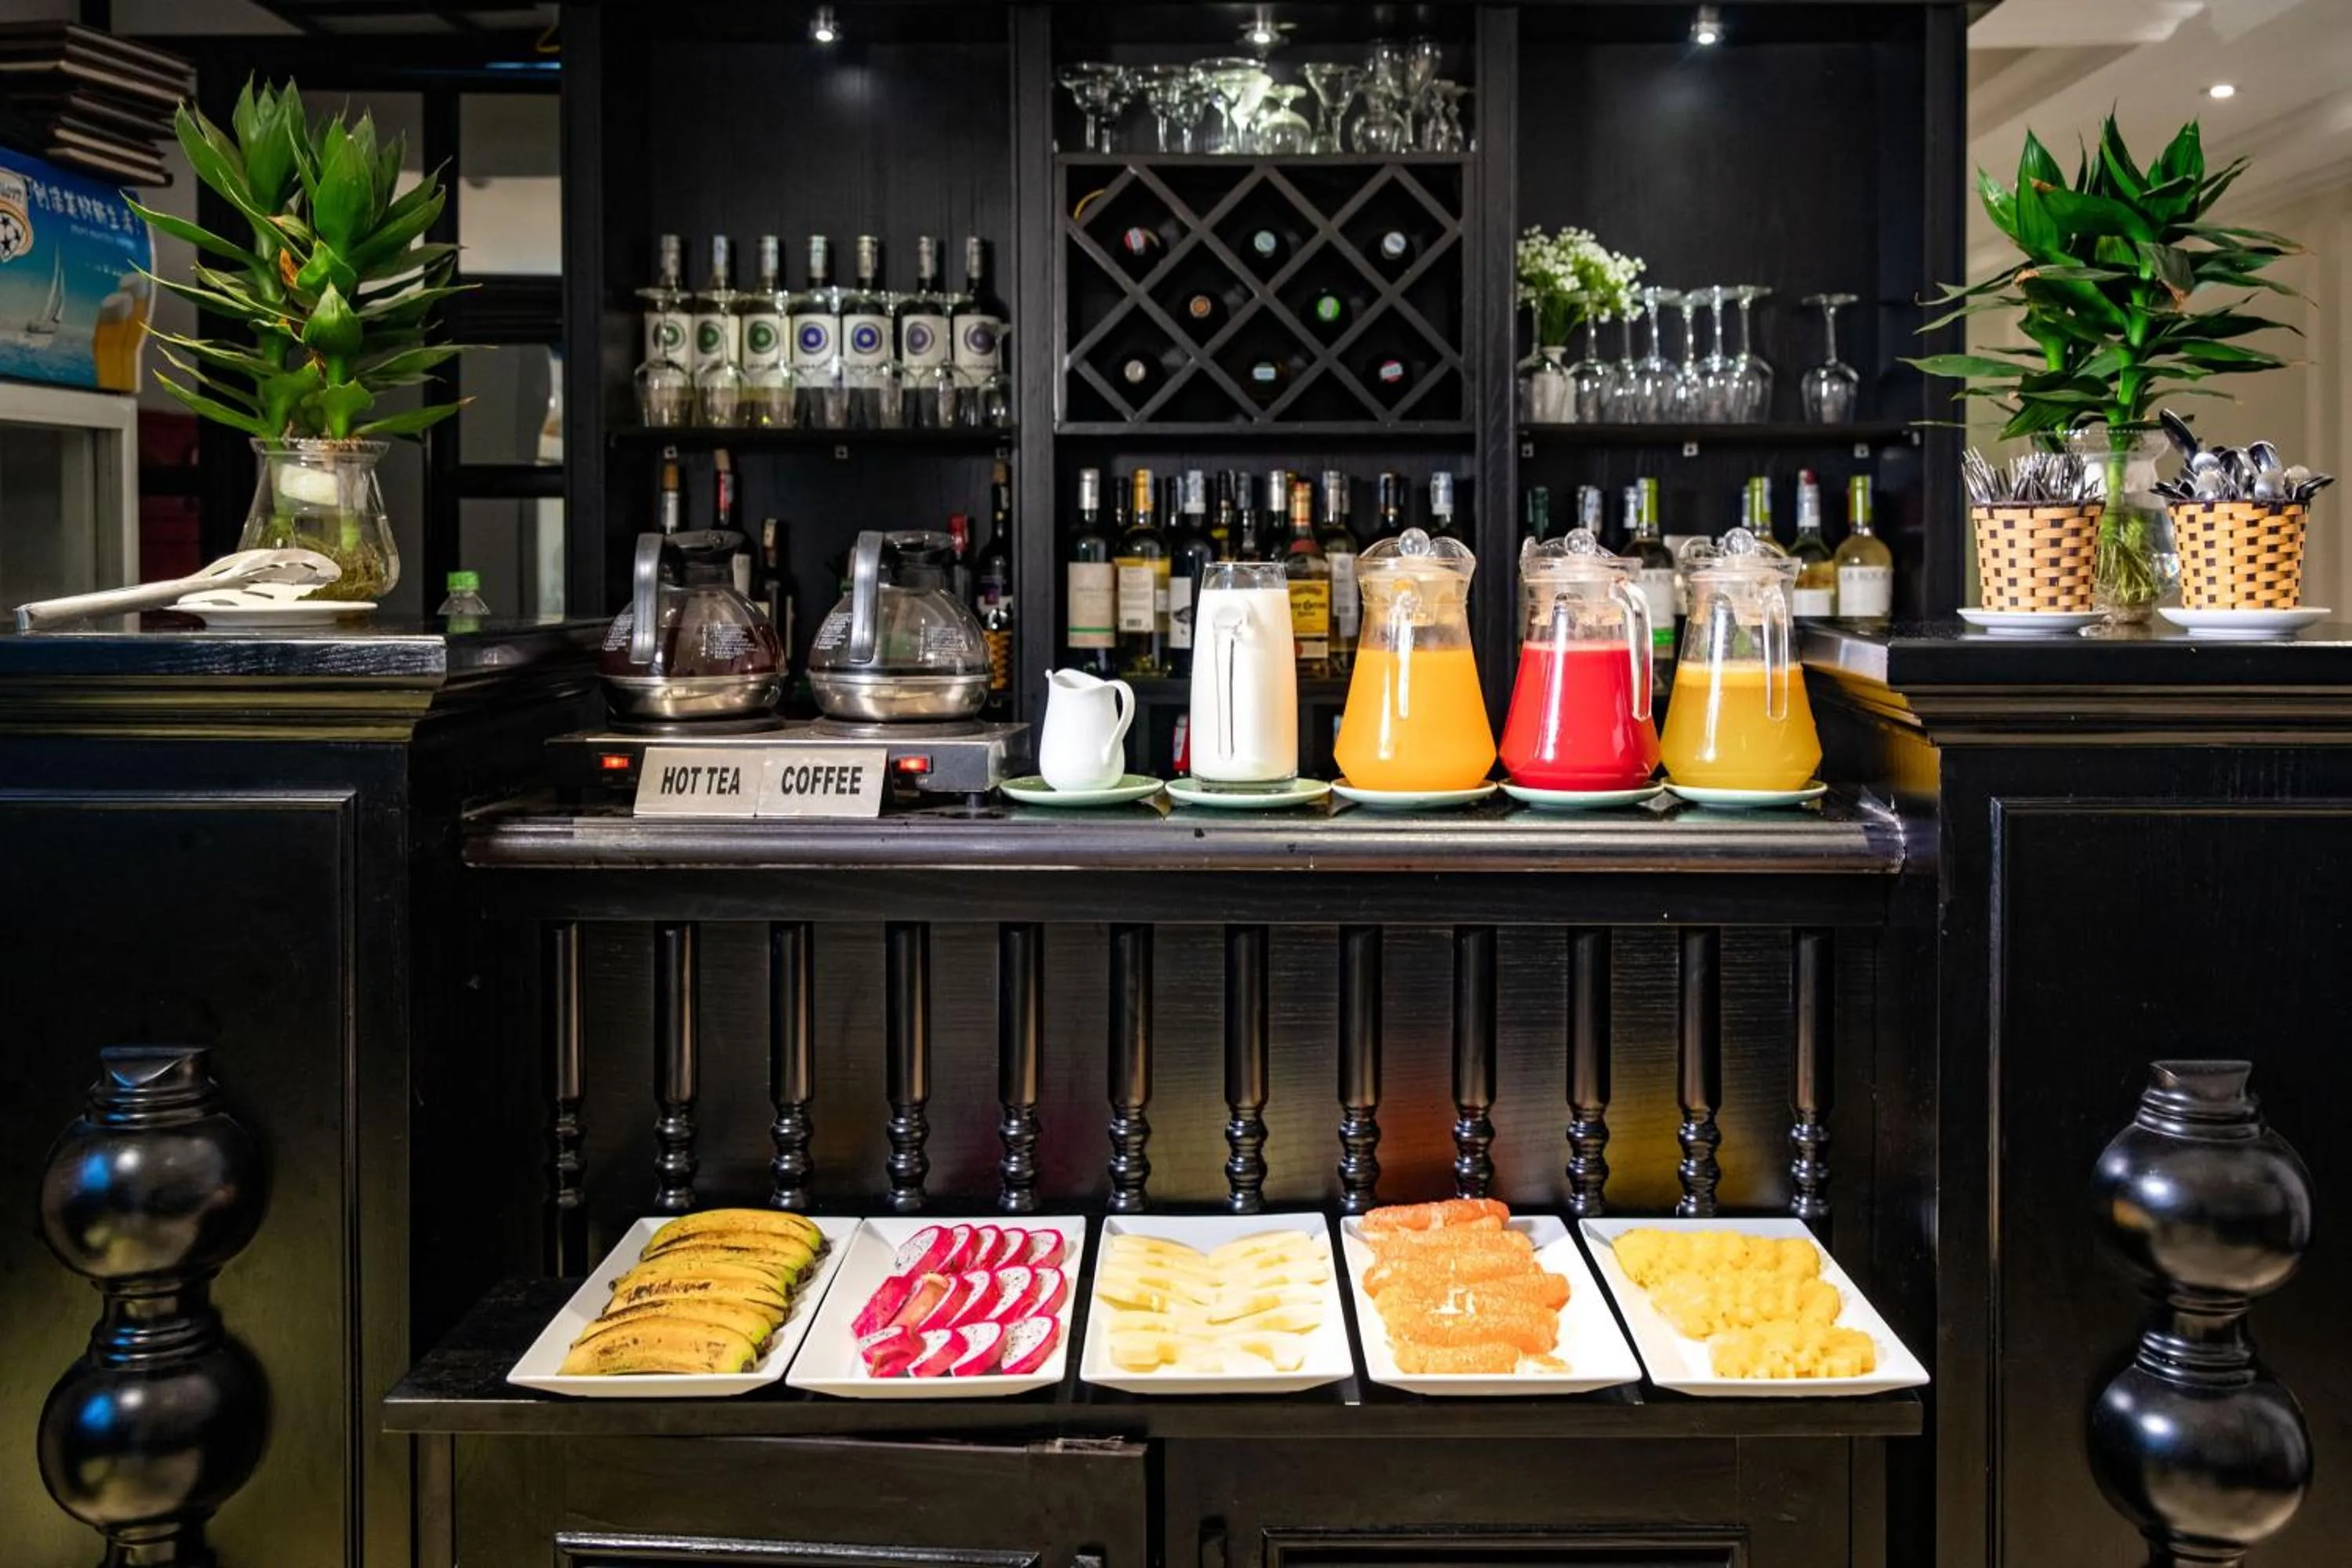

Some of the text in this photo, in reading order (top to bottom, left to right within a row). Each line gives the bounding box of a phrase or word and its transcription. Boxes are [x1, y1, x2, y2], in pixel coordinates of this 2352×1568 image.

[660, 766, 741, 795] HOT TEA
[781, 766, 863, 795] COFFEE
